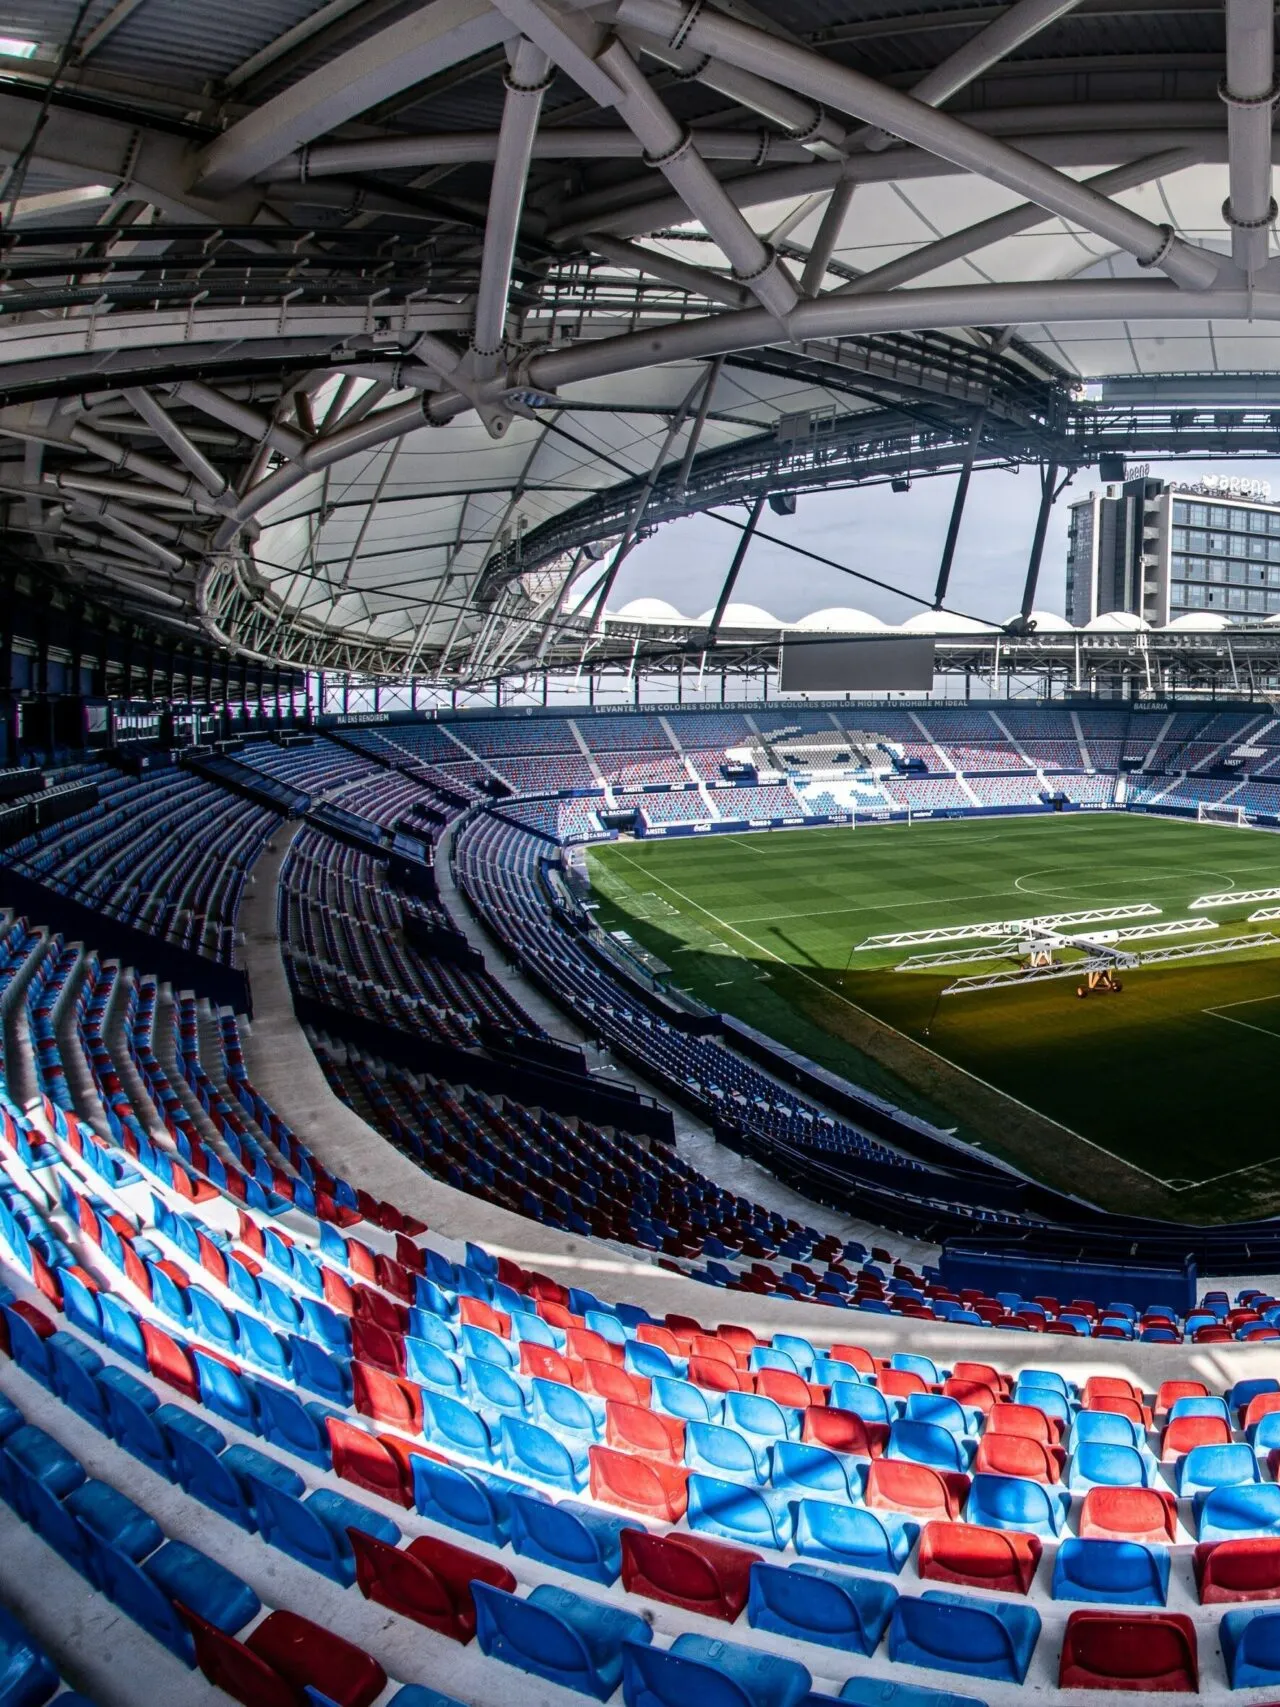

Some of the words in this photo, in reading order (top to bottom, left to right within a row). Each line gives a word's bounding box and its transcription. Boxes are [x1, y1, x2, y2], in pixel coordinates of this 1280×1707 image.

[595, 705, 637, 713] LEVANTE,
[640, 704, 656, 712] TUS
[658, 703, 697, 711] COLORES
[720, 702, 736, 710] LOS
[781, 701, 819, 709] COLORES
